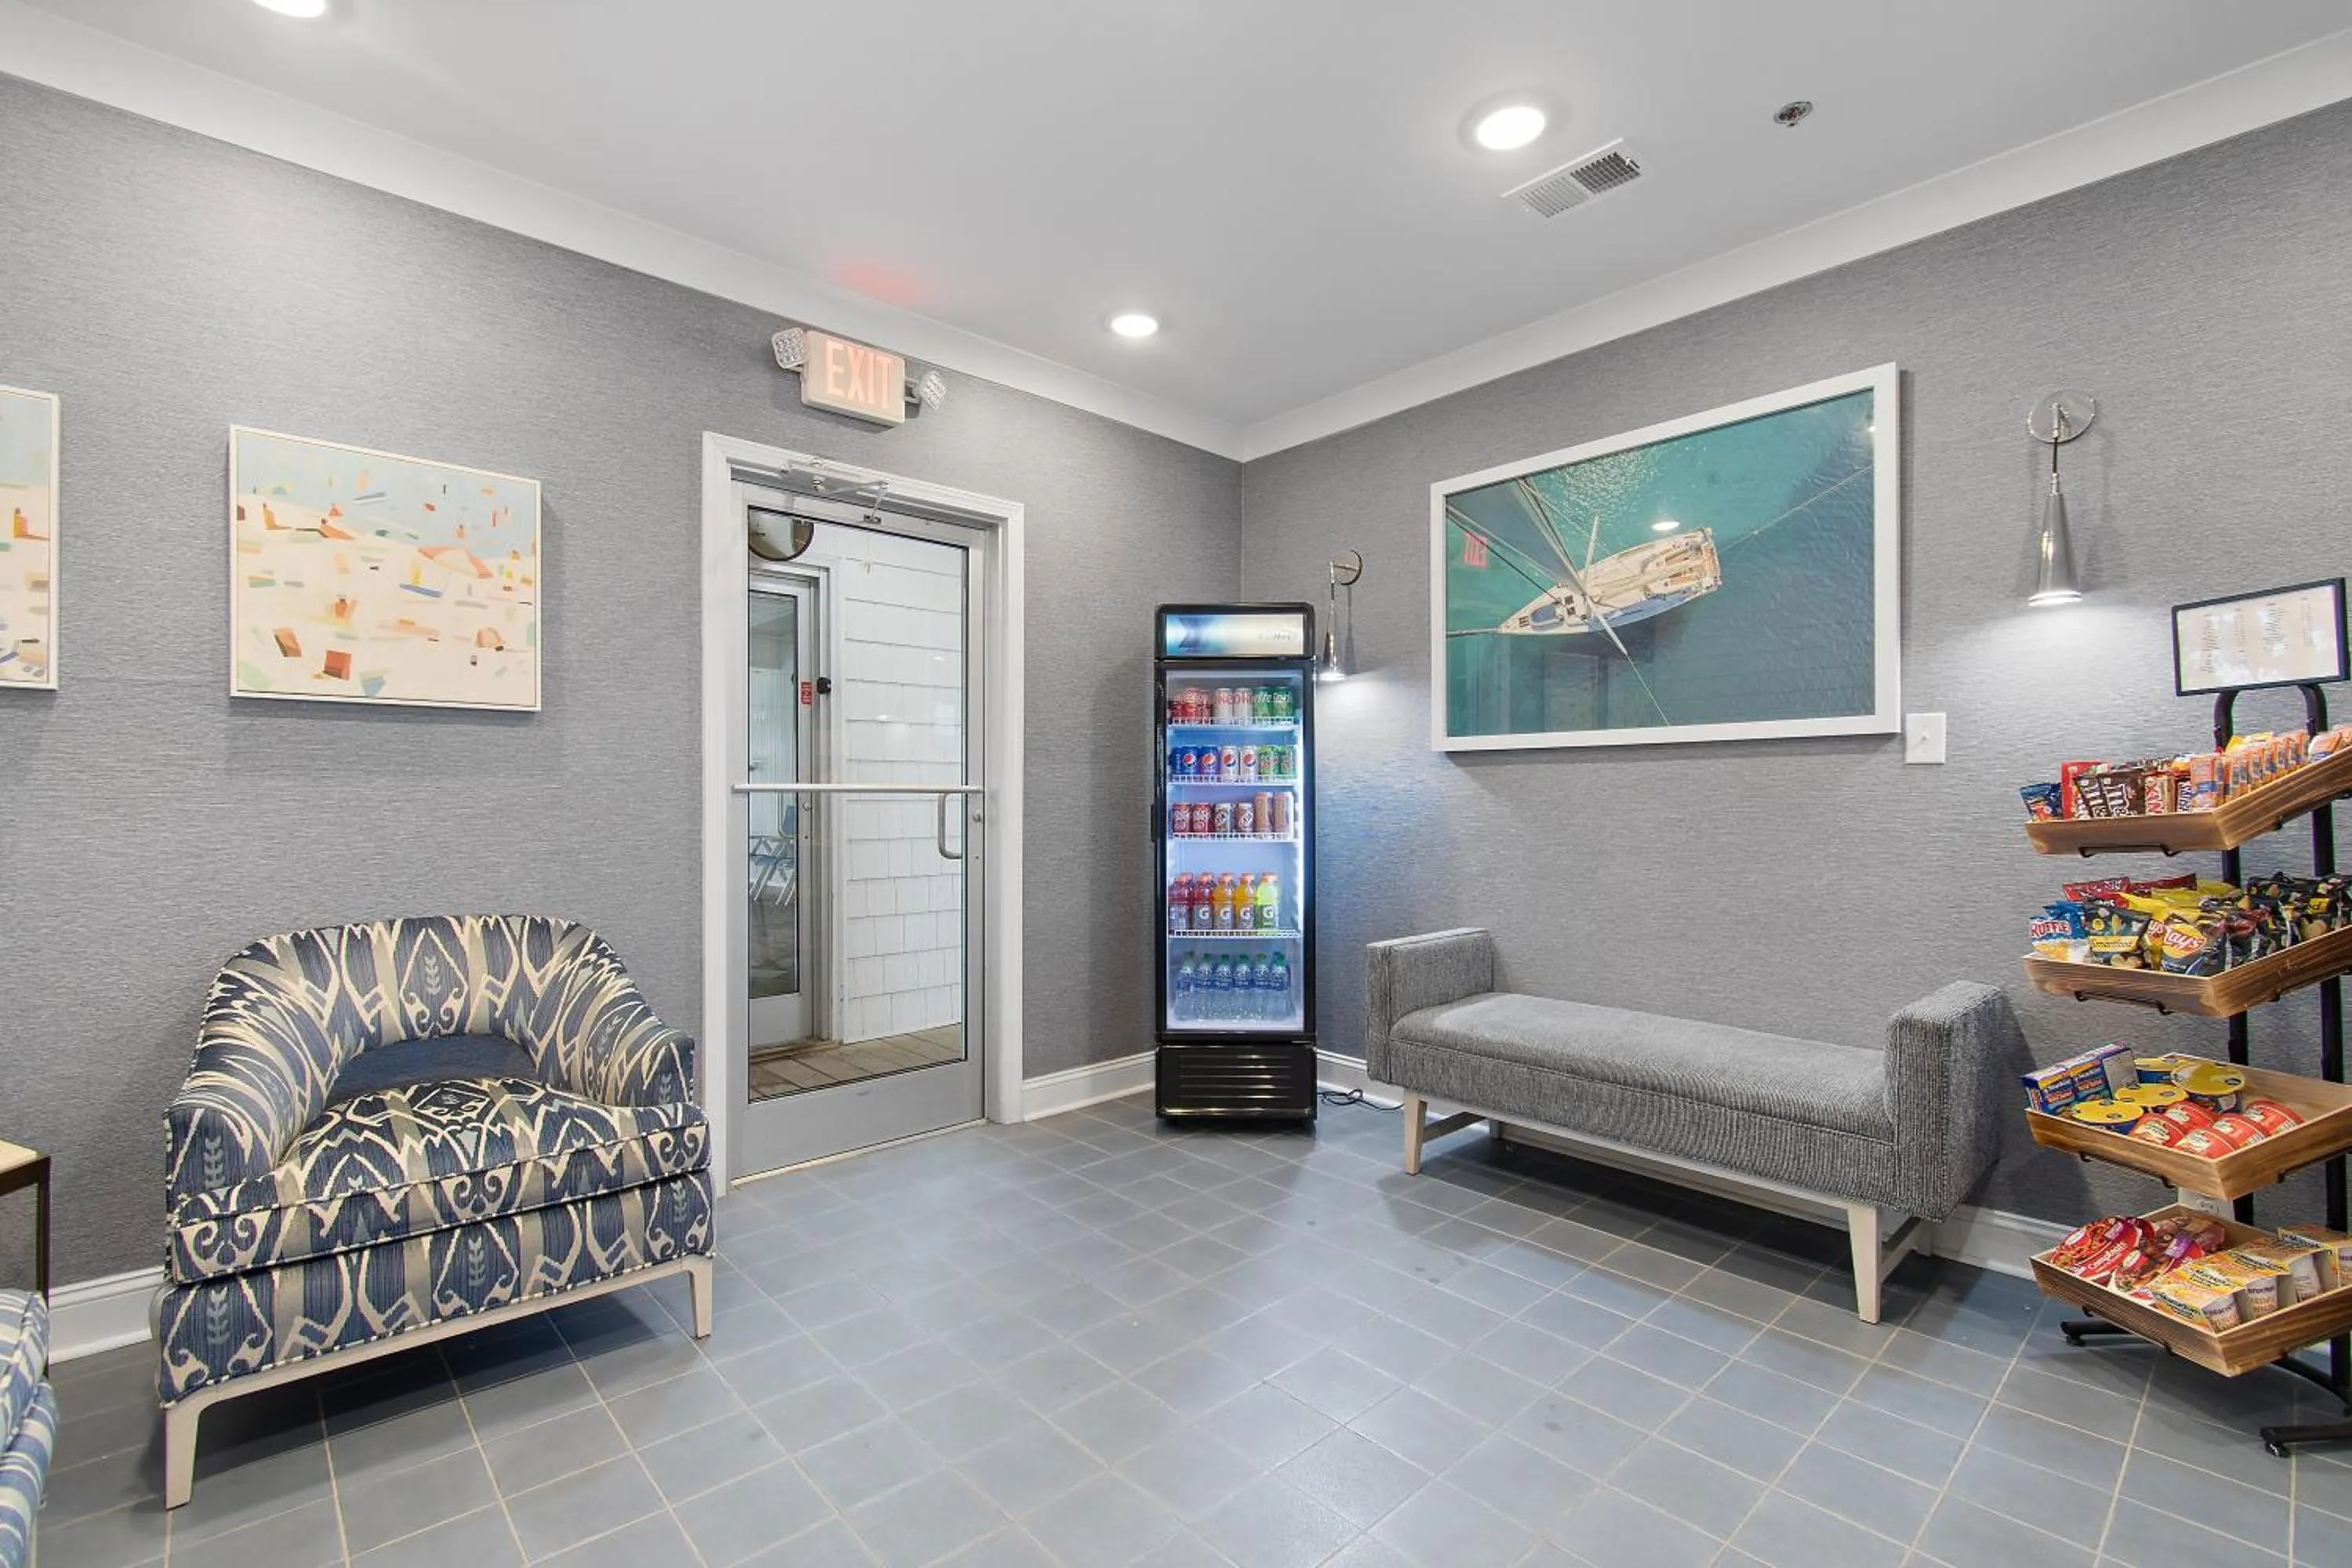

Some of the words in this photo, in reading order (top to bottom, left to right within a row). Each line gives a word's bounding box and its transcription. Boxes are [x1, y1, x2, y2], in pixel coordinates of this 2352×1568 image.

[826, 341, 894, 409] EXIT
[1199, 907, 1210, 920] G
[1220, 907, 1231, 920] G
[1240, 907, 1251, 920] G
[1262, 906, 1274, 919] G
[2031, 921, 2071, 936] RUFFLE
